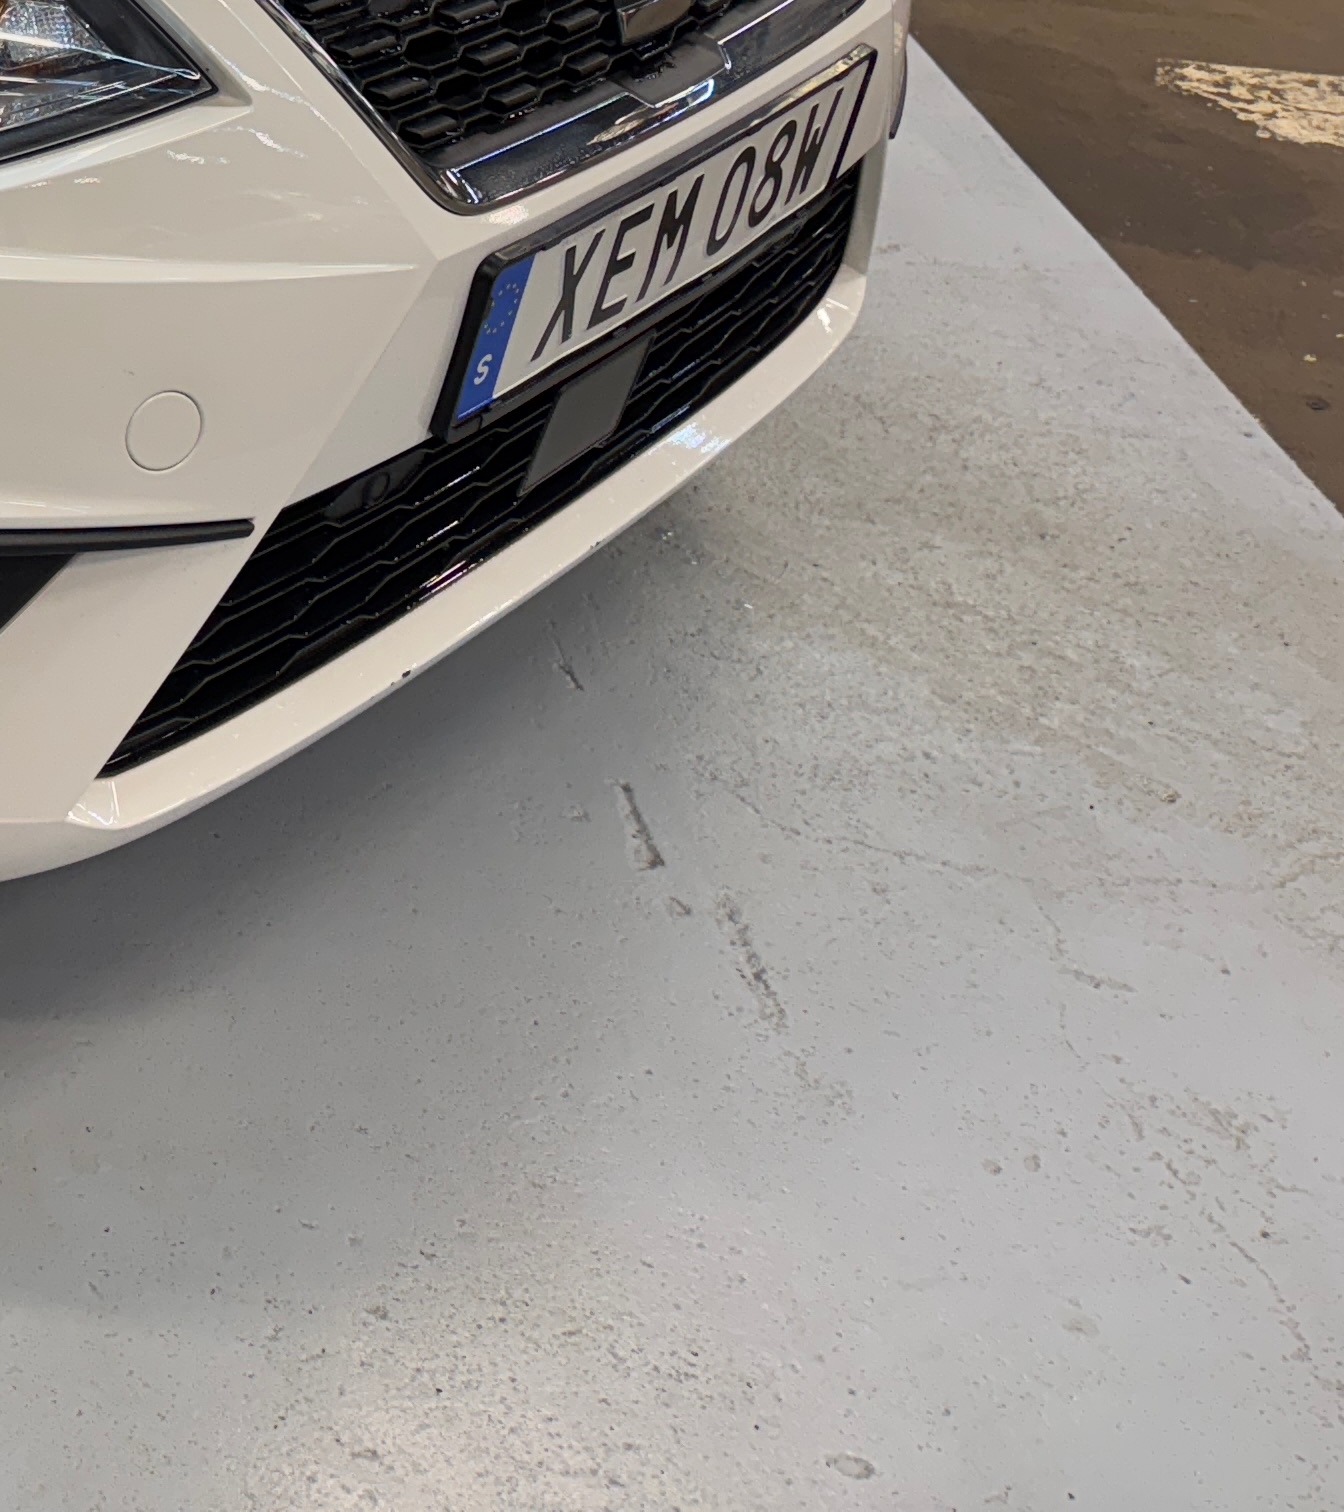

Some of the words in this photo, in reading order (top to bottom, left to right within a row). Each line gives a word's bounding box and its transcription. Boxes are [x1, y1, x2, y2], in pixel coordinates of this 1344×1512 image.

[530, 173, 705, 363] XEM
[705, 86, 845, 256] 08W
[473, 353, 493, 386] S
